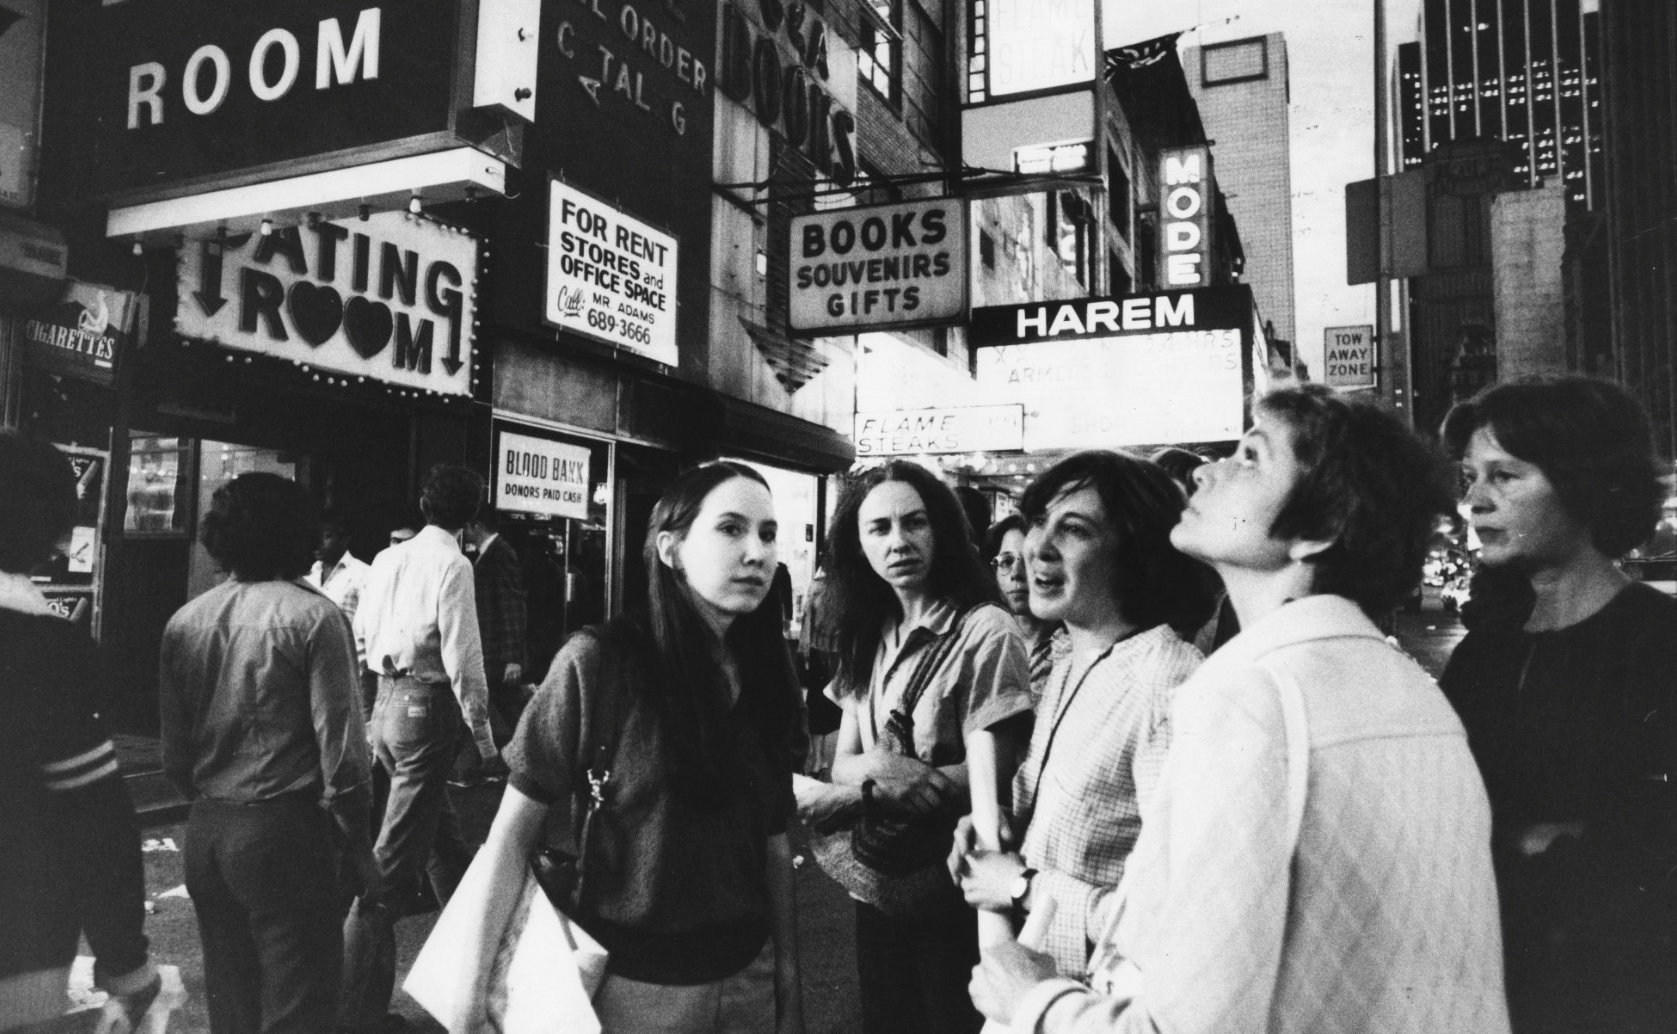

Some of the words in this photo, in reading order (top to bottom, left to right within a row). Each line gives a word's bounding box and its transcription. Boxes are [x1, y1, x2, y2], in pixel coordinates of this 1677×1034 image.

[127, 7, 381, 129] ROOM
[620, 5, 706, 97] ORDER
[562, 198, 607, 242] FOR
[616, 224, 668, 267] RENT
[802, 209, 947, 258] BOOKS
[1166, 154, 1200, 286] MODE
[561, 231, 640, 280] STORES
[643, 272, 663, 290] and
[797, 252, 950, 289] SOUVENIRS
[561, 254, 620, 294] OFFICE
[624, 279, 666, 312] SPACE
[826, 286, 920, 317] GIFTS
[587, 308, 651, 345] 689-3666
[618, 303, 655, 324] ADAMS
[1016, 294, 1195, 338] HAREM
[26, 319, 115, 361] CIGARETTES
[1329, 348, 1368, 360] AWAY
[1335, 335, 1362, 346] TOW
[1329, 363, 1367, 376] ZONE
[862, 415, 957, 434] FLAME
[858, 434, 959, 454] STEAKS
[506, 450, 548, 479] BLOOD
[505, 483, 540, 499] DONORS
[542, 488, 561, 501] PAID
[563, 491, 582, 503] CASH
